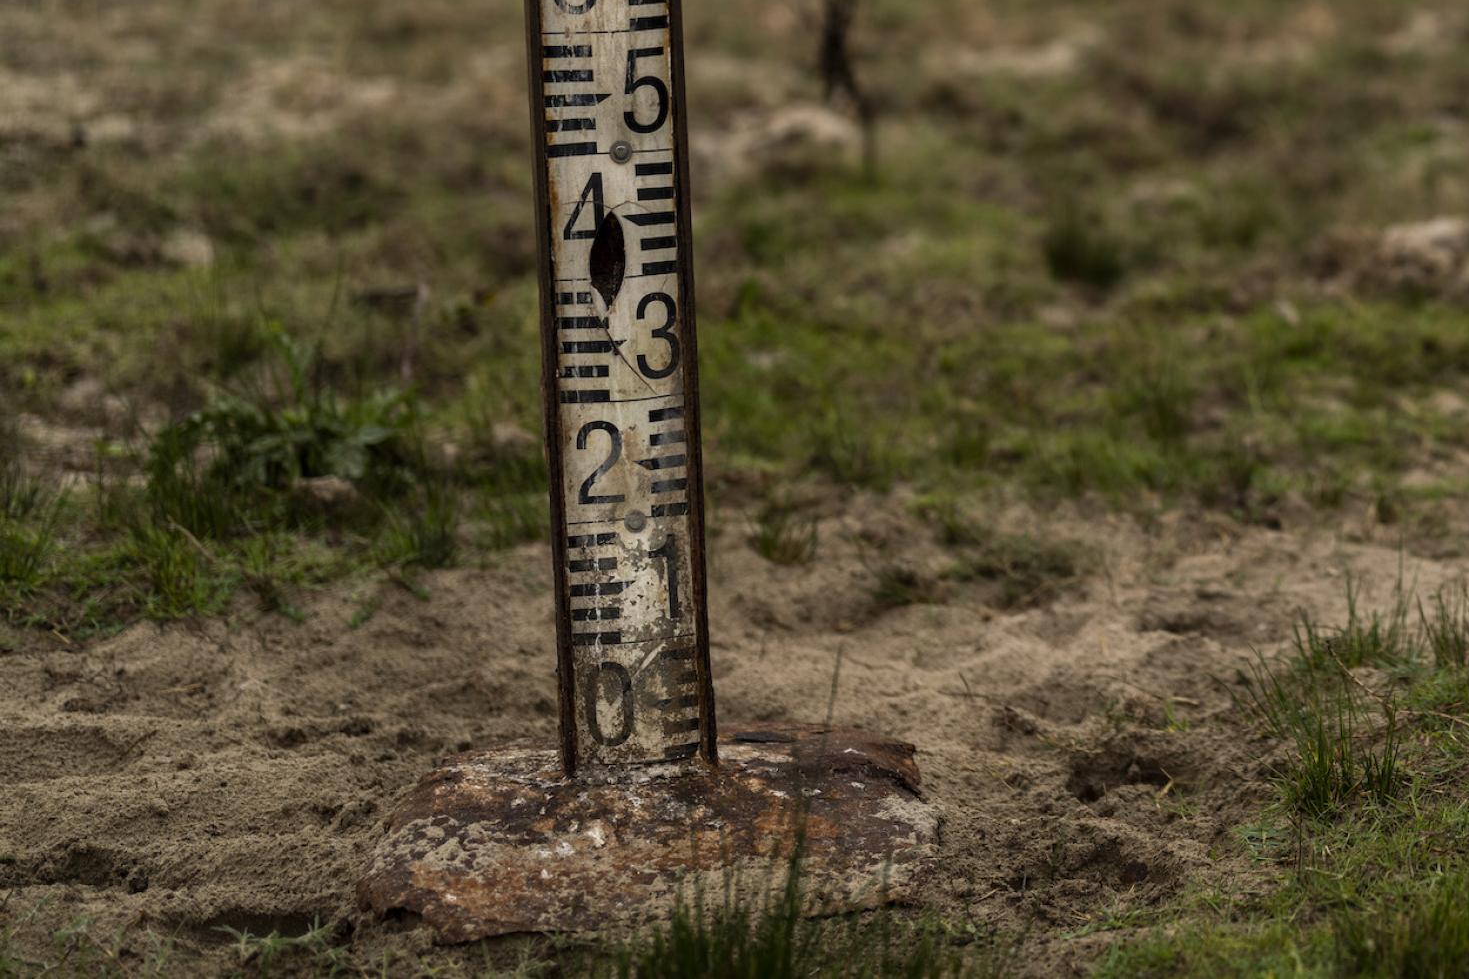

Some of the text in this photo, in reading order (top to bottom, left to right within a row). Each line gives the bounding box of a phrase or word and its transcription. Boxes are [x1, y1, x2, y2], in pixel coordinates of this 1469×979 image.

[623, 46, 670, 134] 5
[563, 171, 605, 241] 4
[635, 291, 681, 380] 3
[576, 419, 626, 505] 2
[647, 533, 680, 619] 1
[585, 660, 635, 747] 0
